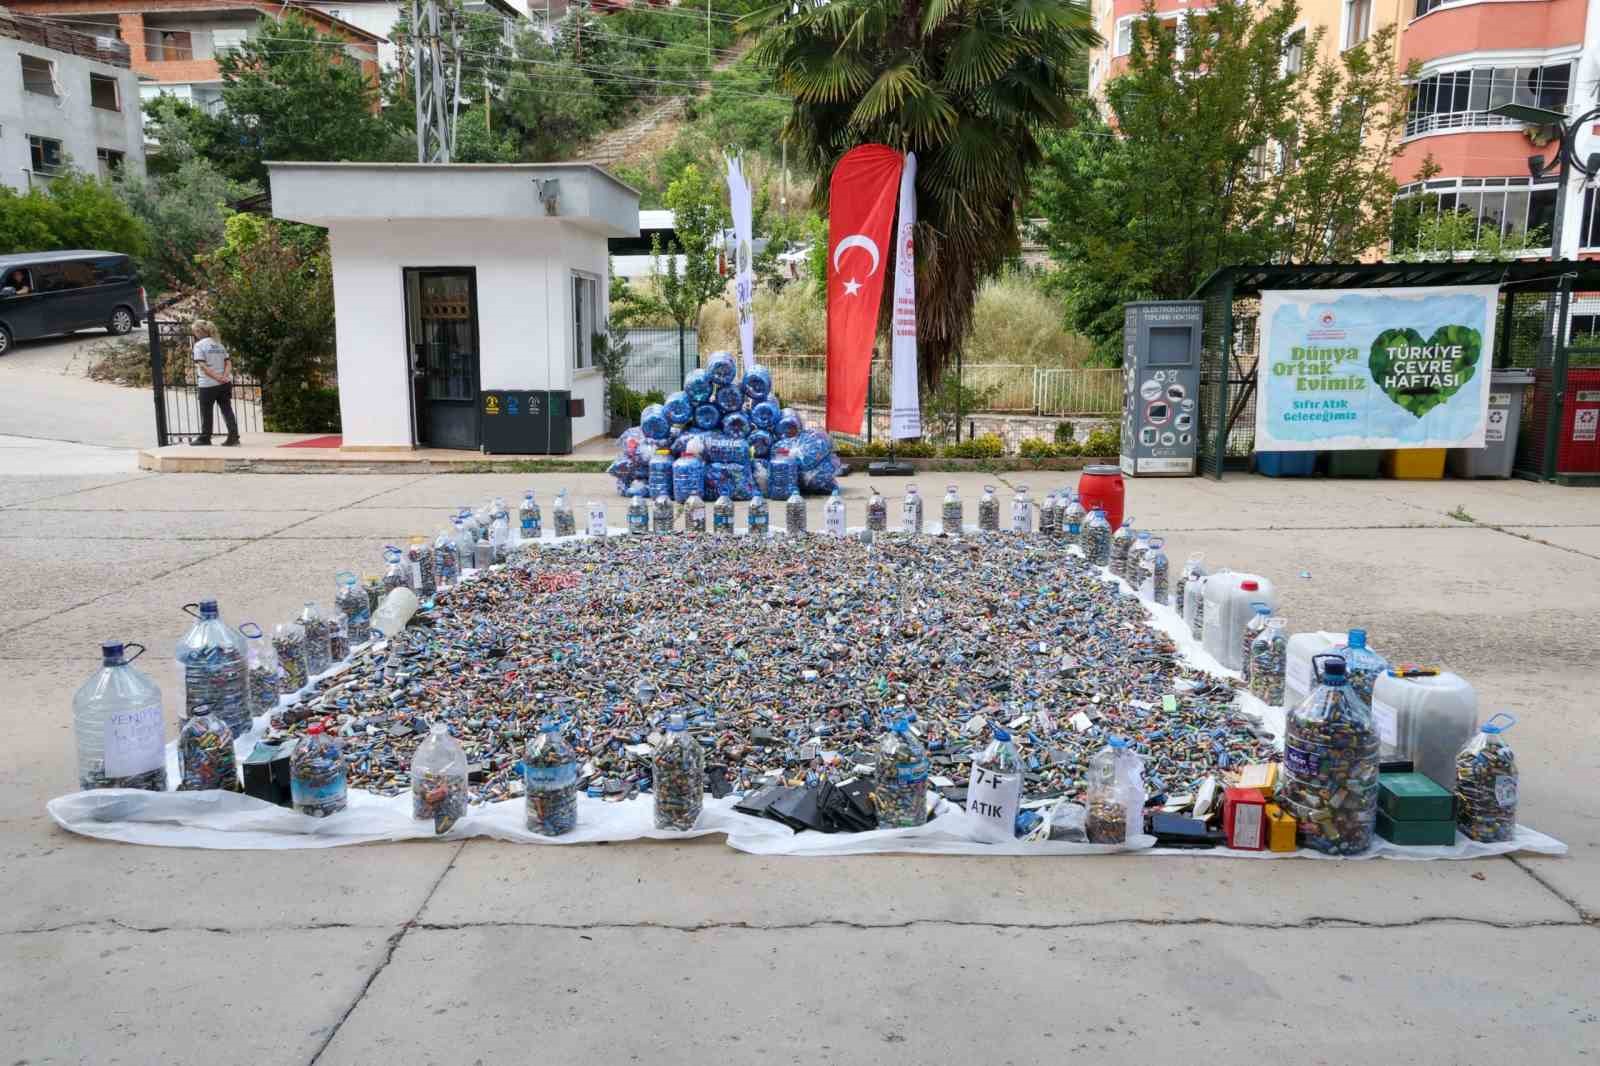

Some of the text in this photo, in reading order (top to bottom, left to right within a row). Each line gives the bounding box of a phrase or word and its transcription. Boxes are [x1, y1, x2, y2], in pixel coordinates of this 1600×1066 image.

[1291, 346, 1359, 364] Dünya
[1385, 343, 1463, 360] TÜRKİYE
[1272, 361, 1333, 376] Ortak
[1393, 360, 1452, 376] ÇEVRE
[1296, 375, 1367, 391] Evimiz
[1385, 374, 1460, 388] HAFTASI
[1322, 399, 1349, 409] Atık
[976, 768, 1002, 789] 7-F
[971, 800, 1002, 818] ATIK
